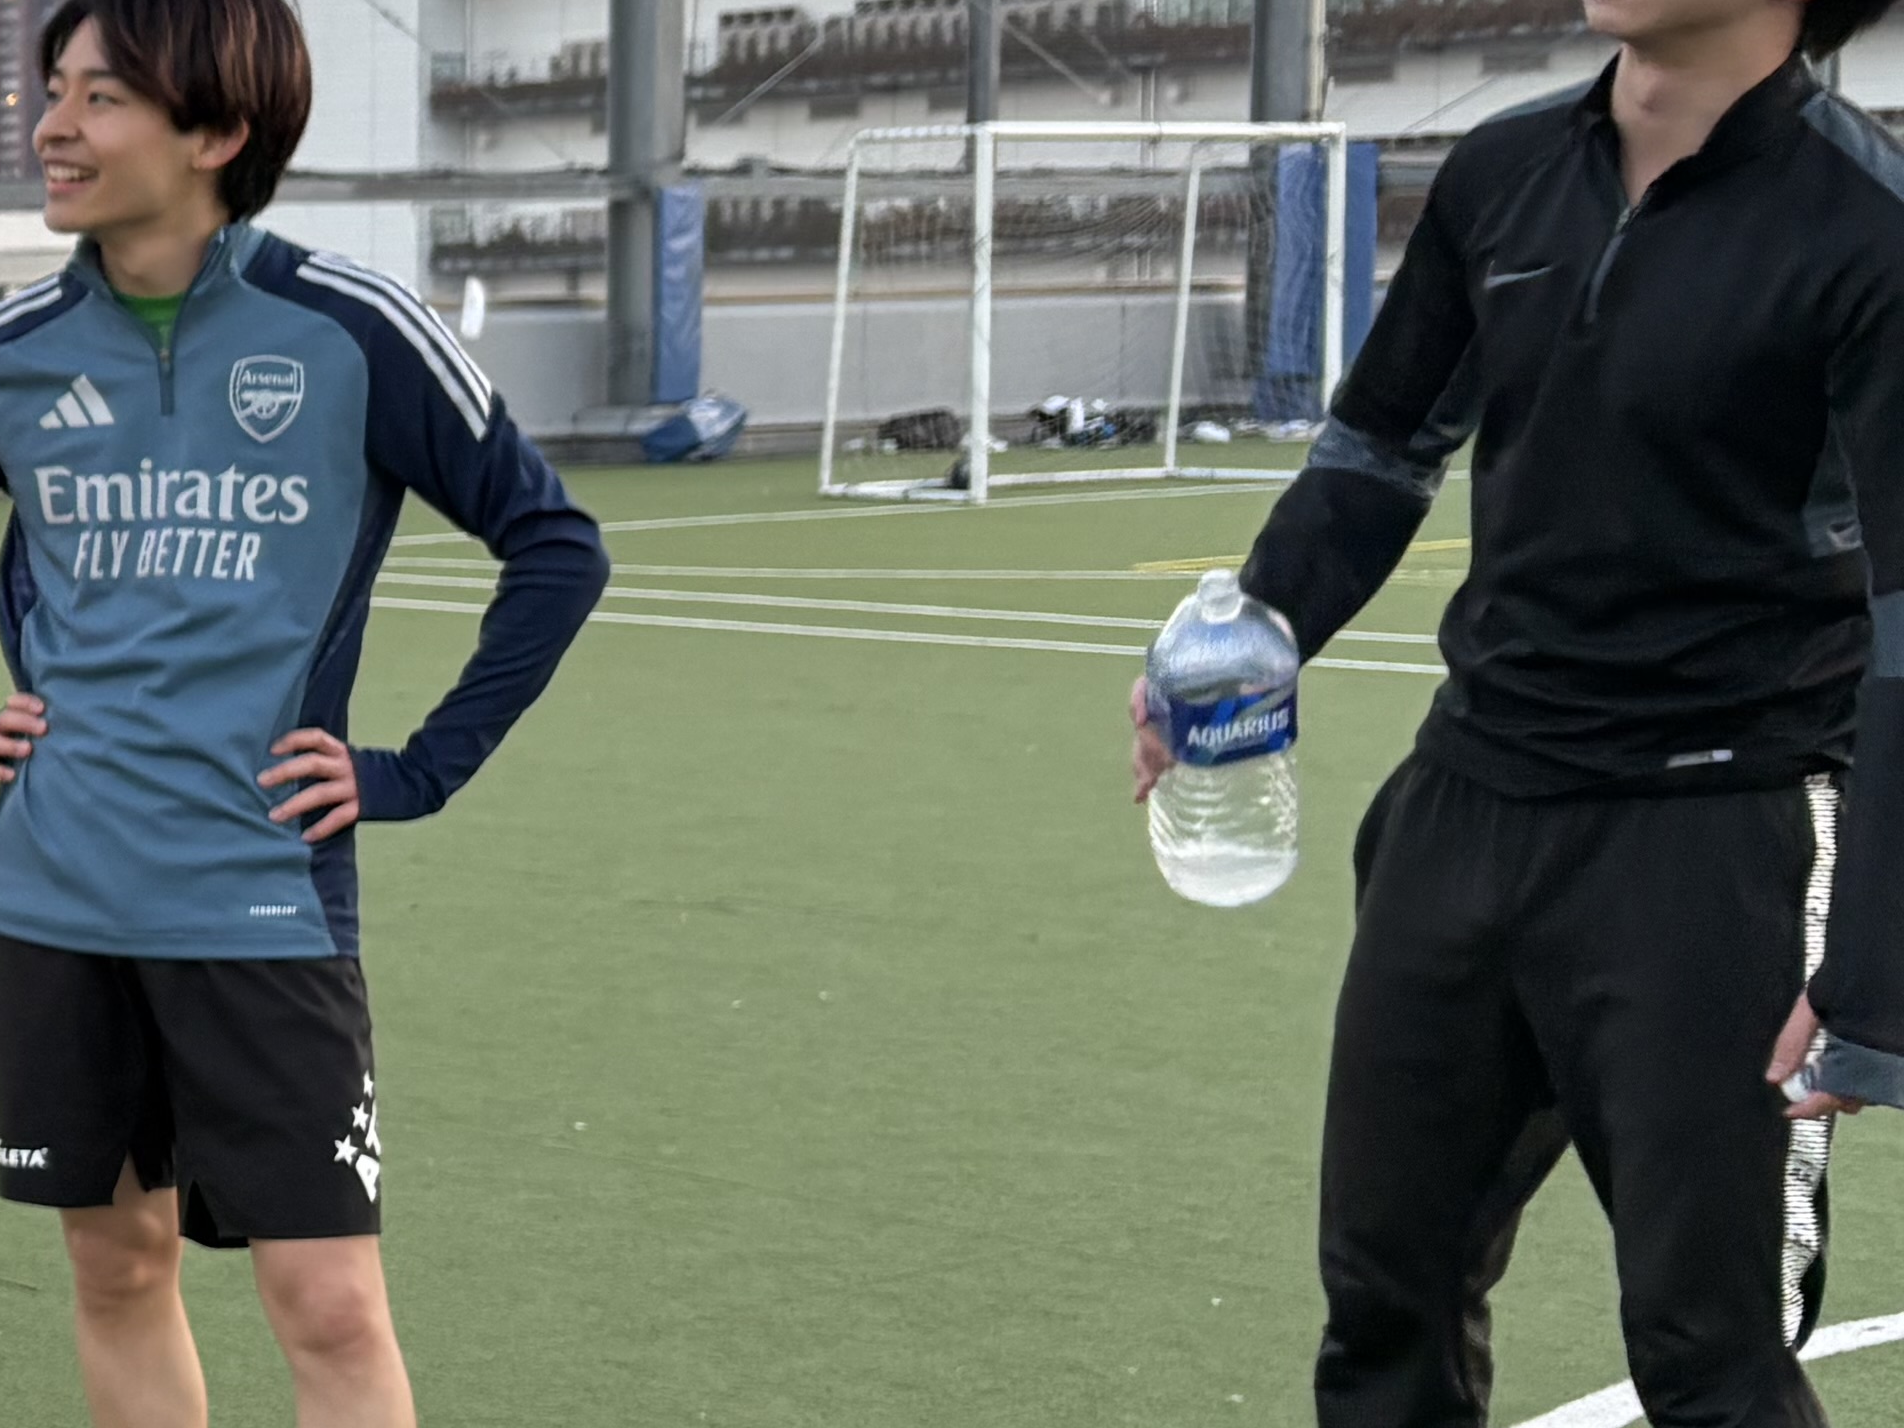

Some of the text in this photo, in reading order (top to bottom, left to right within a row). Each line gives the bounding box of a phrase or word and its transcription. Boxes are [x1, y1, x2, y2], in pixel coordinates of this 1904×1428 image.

[241, 370, 294, 386] Arsenal
[33, 457, 309, 525] Emirates
[73, 527, 261, 581] FLY BETTER
[1187, 708, 1290, 748] AQUARIUS
